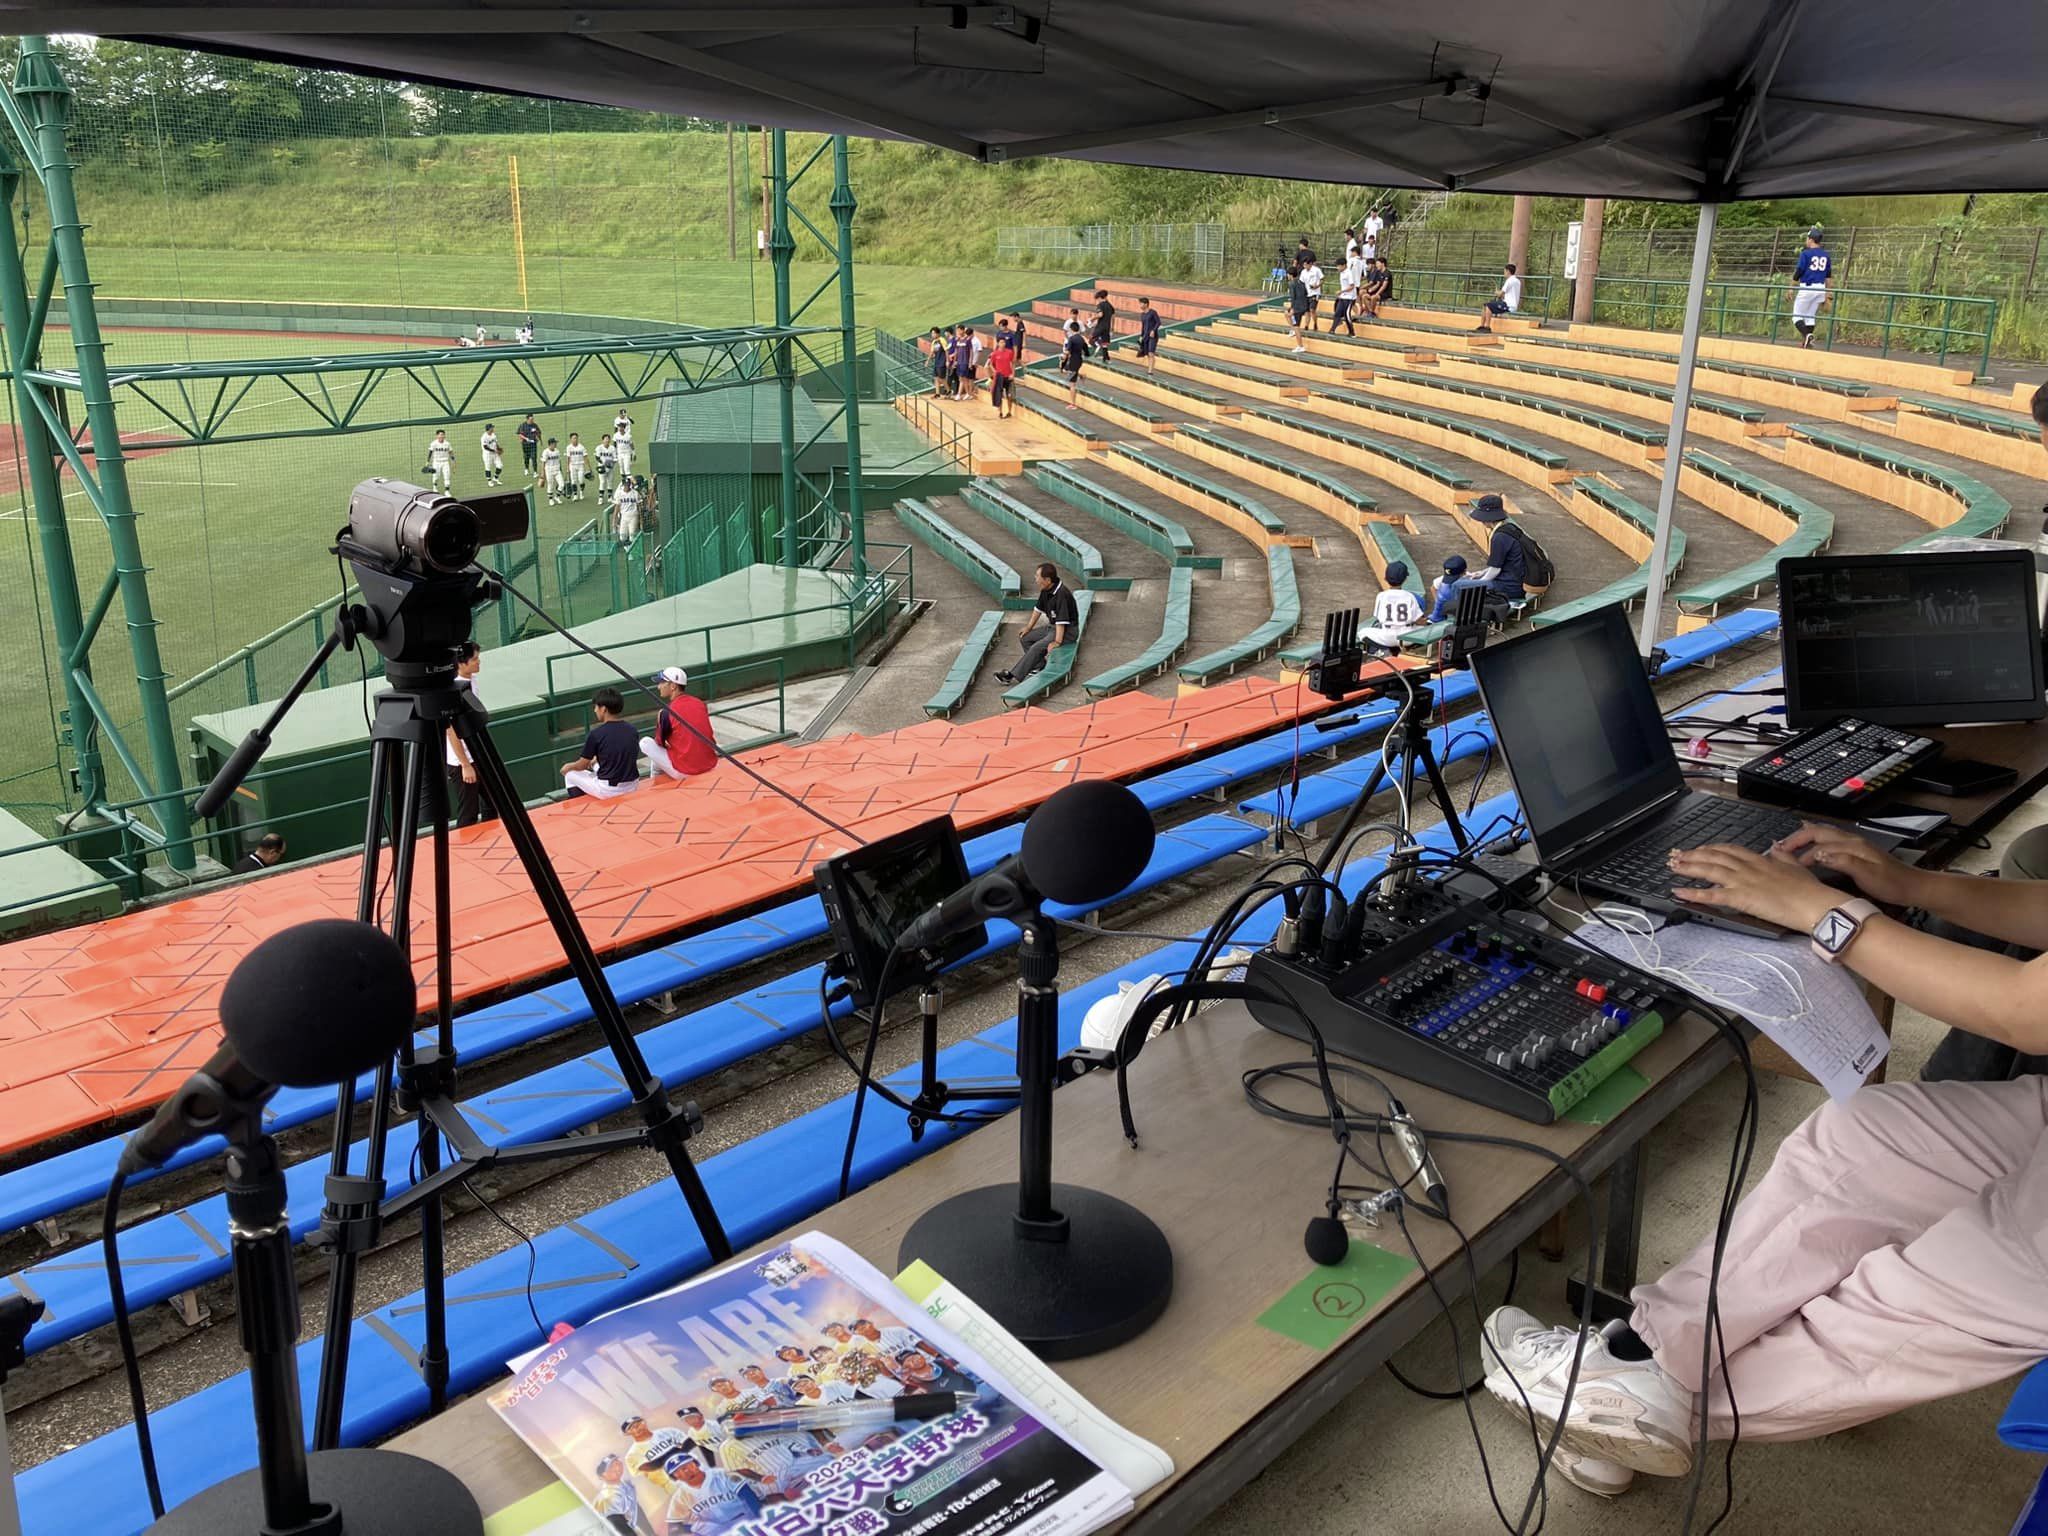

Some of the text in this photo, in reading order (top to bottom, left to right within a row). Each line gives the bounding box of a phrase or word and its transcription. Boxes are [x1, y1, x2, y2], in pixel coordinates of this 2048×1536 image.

[1809, 255, 1828, 272] 39
[1385, 603, 1408, 622] 18
[559, 1285, 818, 1416] WE ARE
[808, 1447, 870, 1486] 2023年
